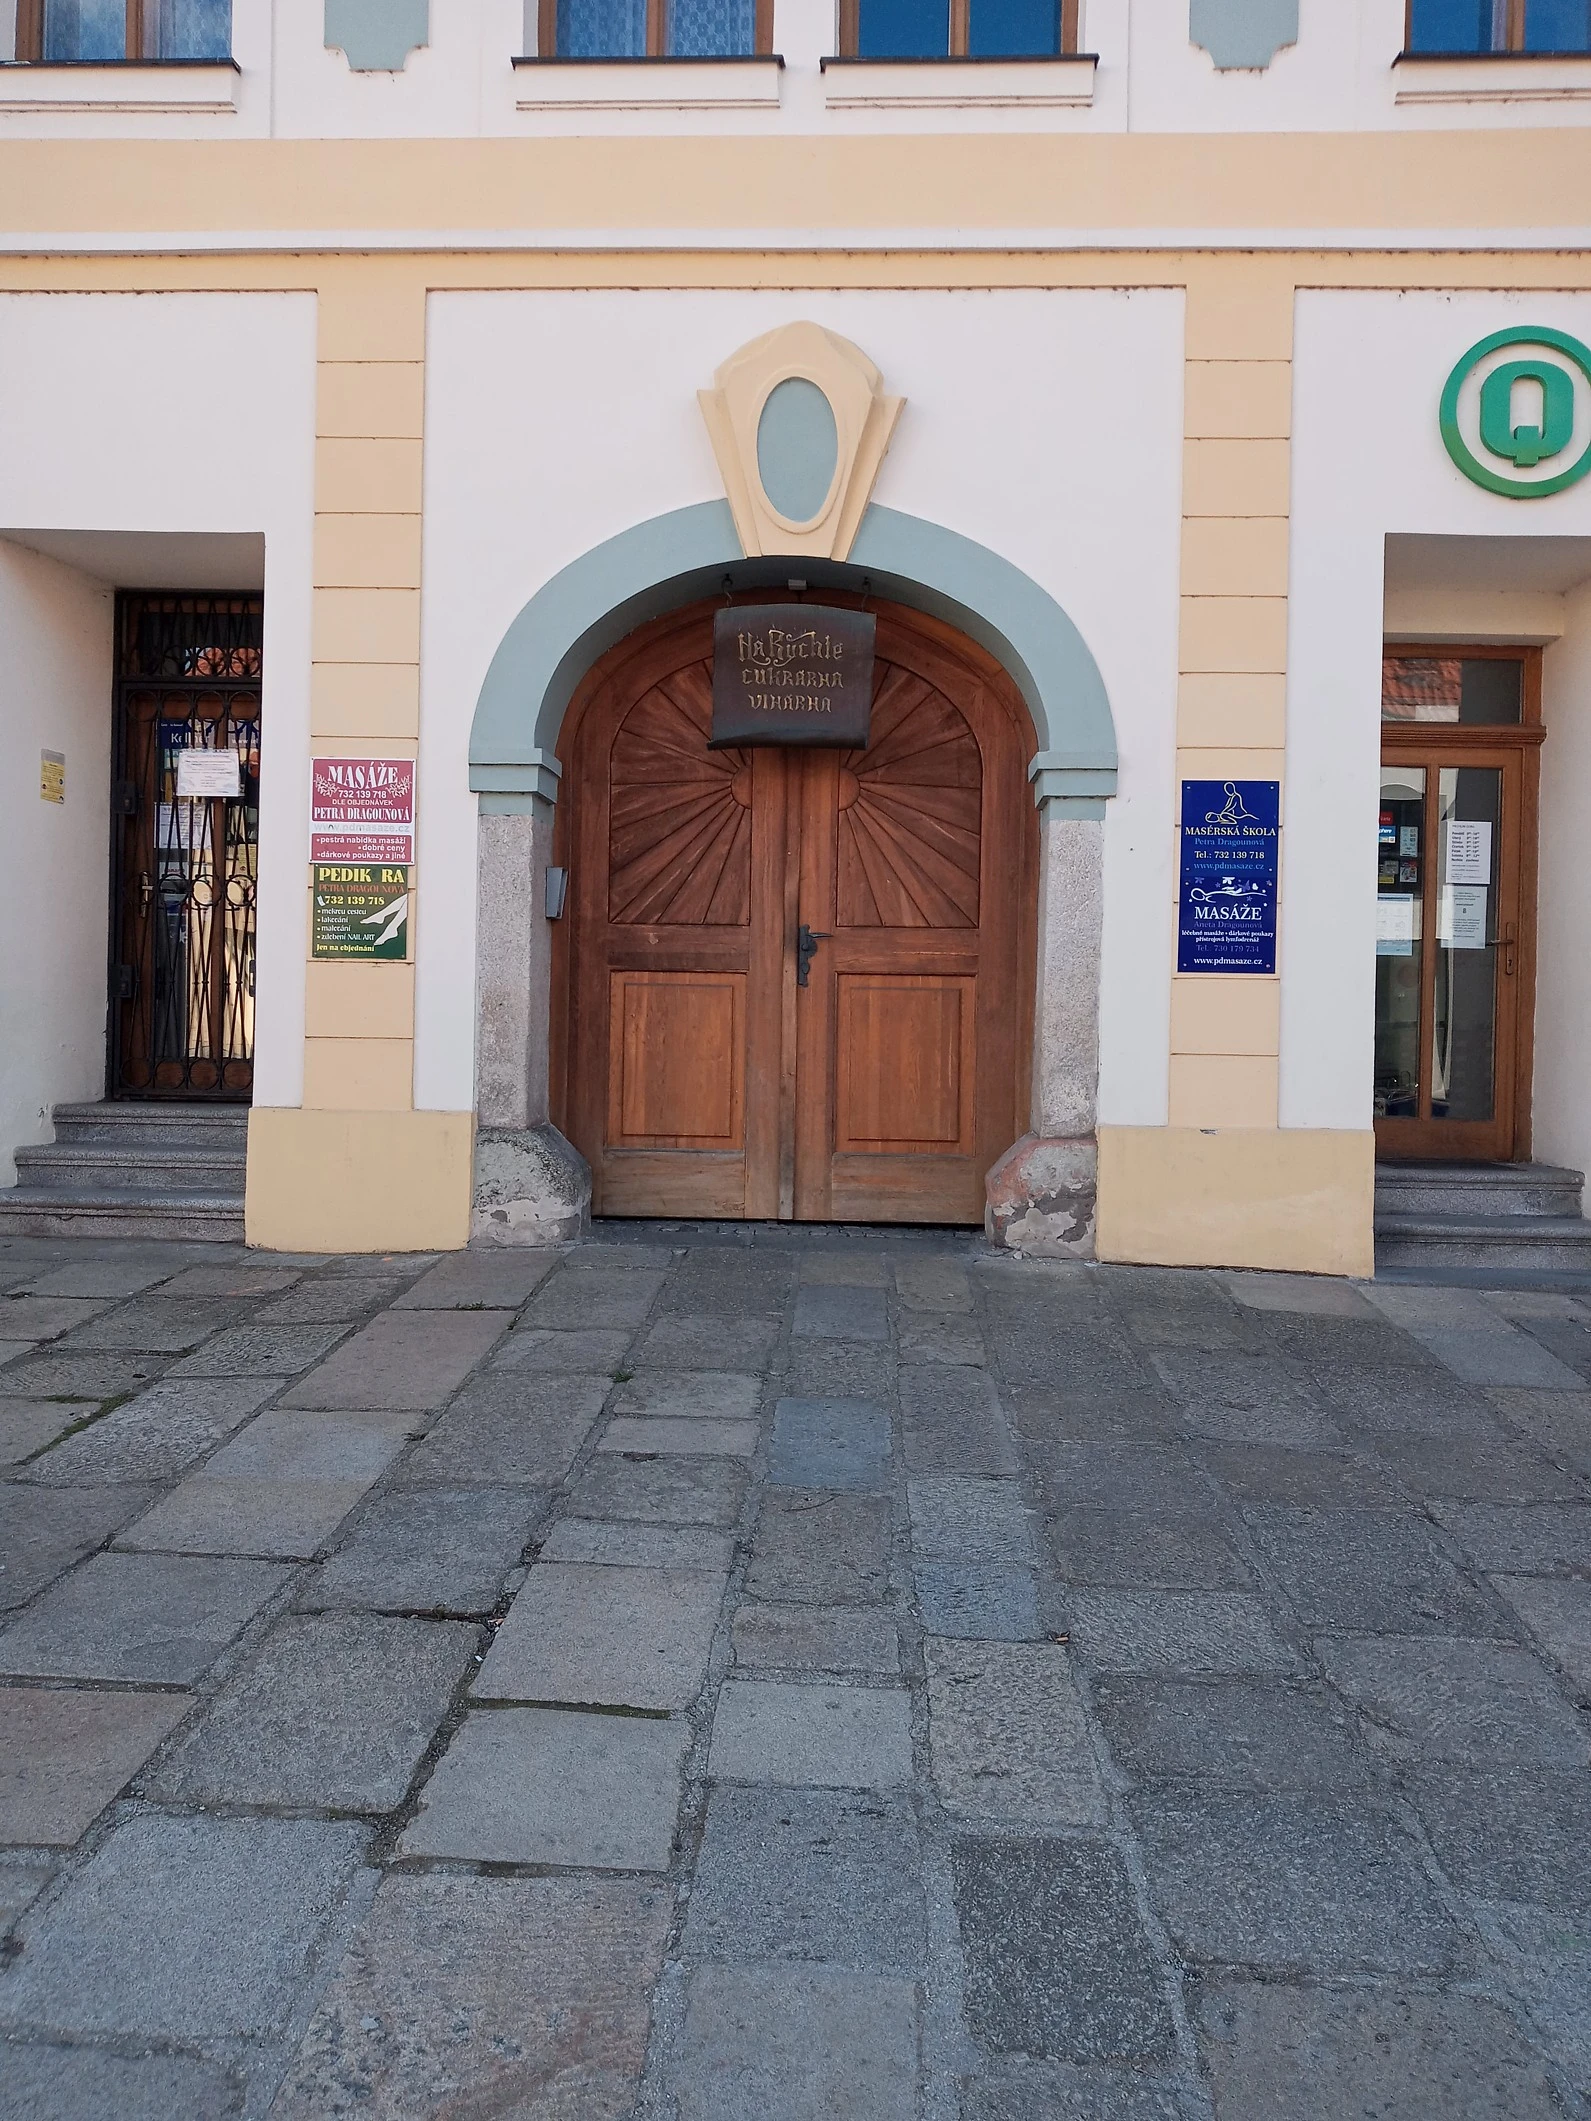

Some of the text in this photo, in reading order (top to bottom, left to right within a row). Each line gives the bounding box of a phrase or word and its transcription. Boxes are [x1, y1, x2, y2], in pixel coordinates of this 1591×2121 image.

[737, 628, 771, 666] Na
[328, 762, 398, 789] MASÁŽE
[338, 789, 387, 799] 732 139 718
[314, 806, 410, 821] PETRA DRAGOUNOVÁ
[1185, 825, 1276, 836] MASÉRSKÁ ŠKOLA
[1217, 838, 1265, 847] Dragounová
[321, 852, 351, 860] dárkové
[1194, 851, 1212, 859] Tel.:
[1214, 851, 1230, 859] 732
[1232, 851, 1247, 859] 139
[1193, 862, 1265, 870] www.pdmasaze.cz
[318, 883, 345, 892] PETRA
[324, 896, 385, 906] 732 139 718
[1194, 903, 1263, 920] MASÁŽE
[1217, 921, 1263, 929] Dragounová
[1193, 956, 1263, 966] www.pdmasaze.cz
